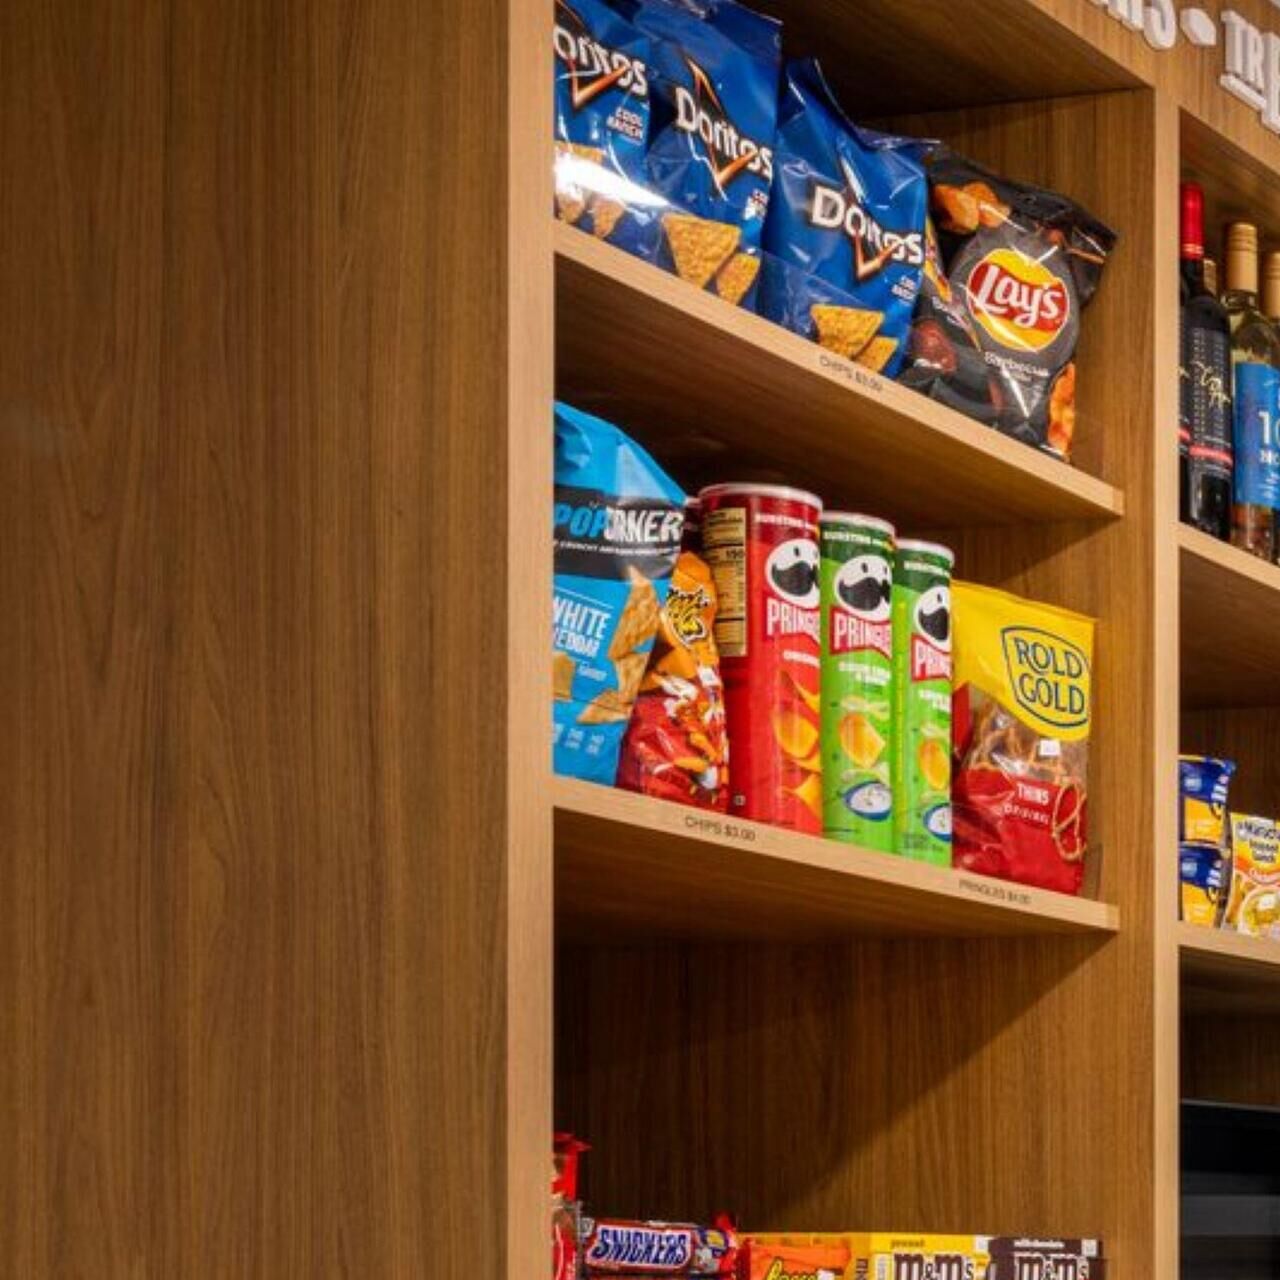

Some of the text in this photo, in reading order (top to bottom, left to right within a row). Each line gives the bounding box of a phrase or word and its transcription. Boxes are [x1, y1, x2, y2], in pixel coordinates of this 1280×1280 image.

[553, 25, 648, 96] oritos
[675, 86, 774, 182] Doritos
[976, 264, 1062, 327] Lay's
[1013, 636, 1083, 679] ROLD
[1019, 672, 1085, 716] GOLD
[685, 815, 723, 835] CHIPS
[591, 1227, 688, 1266] SNICKERS
